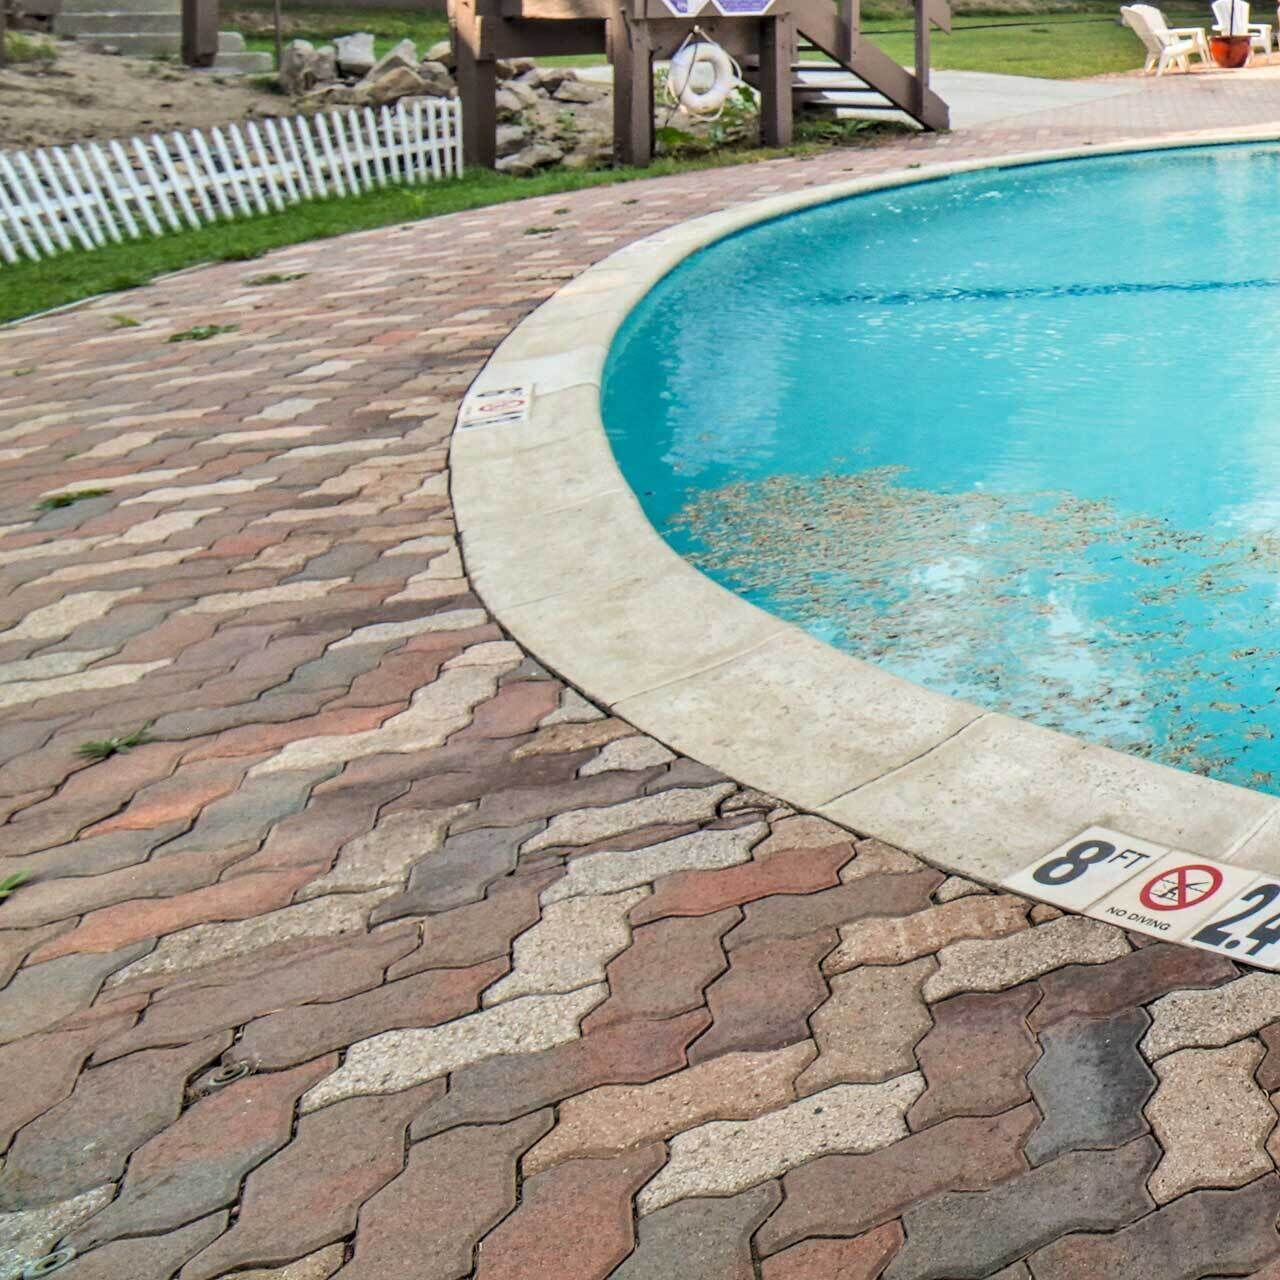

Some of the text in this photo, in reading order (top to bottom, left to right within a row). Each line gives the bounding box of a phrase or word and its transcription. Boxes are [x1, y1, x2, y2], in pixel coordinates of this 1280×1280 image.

[1032, 840, 1151, 886] 8 FT
[1105, 906, 1171, 932] NO DIVING
